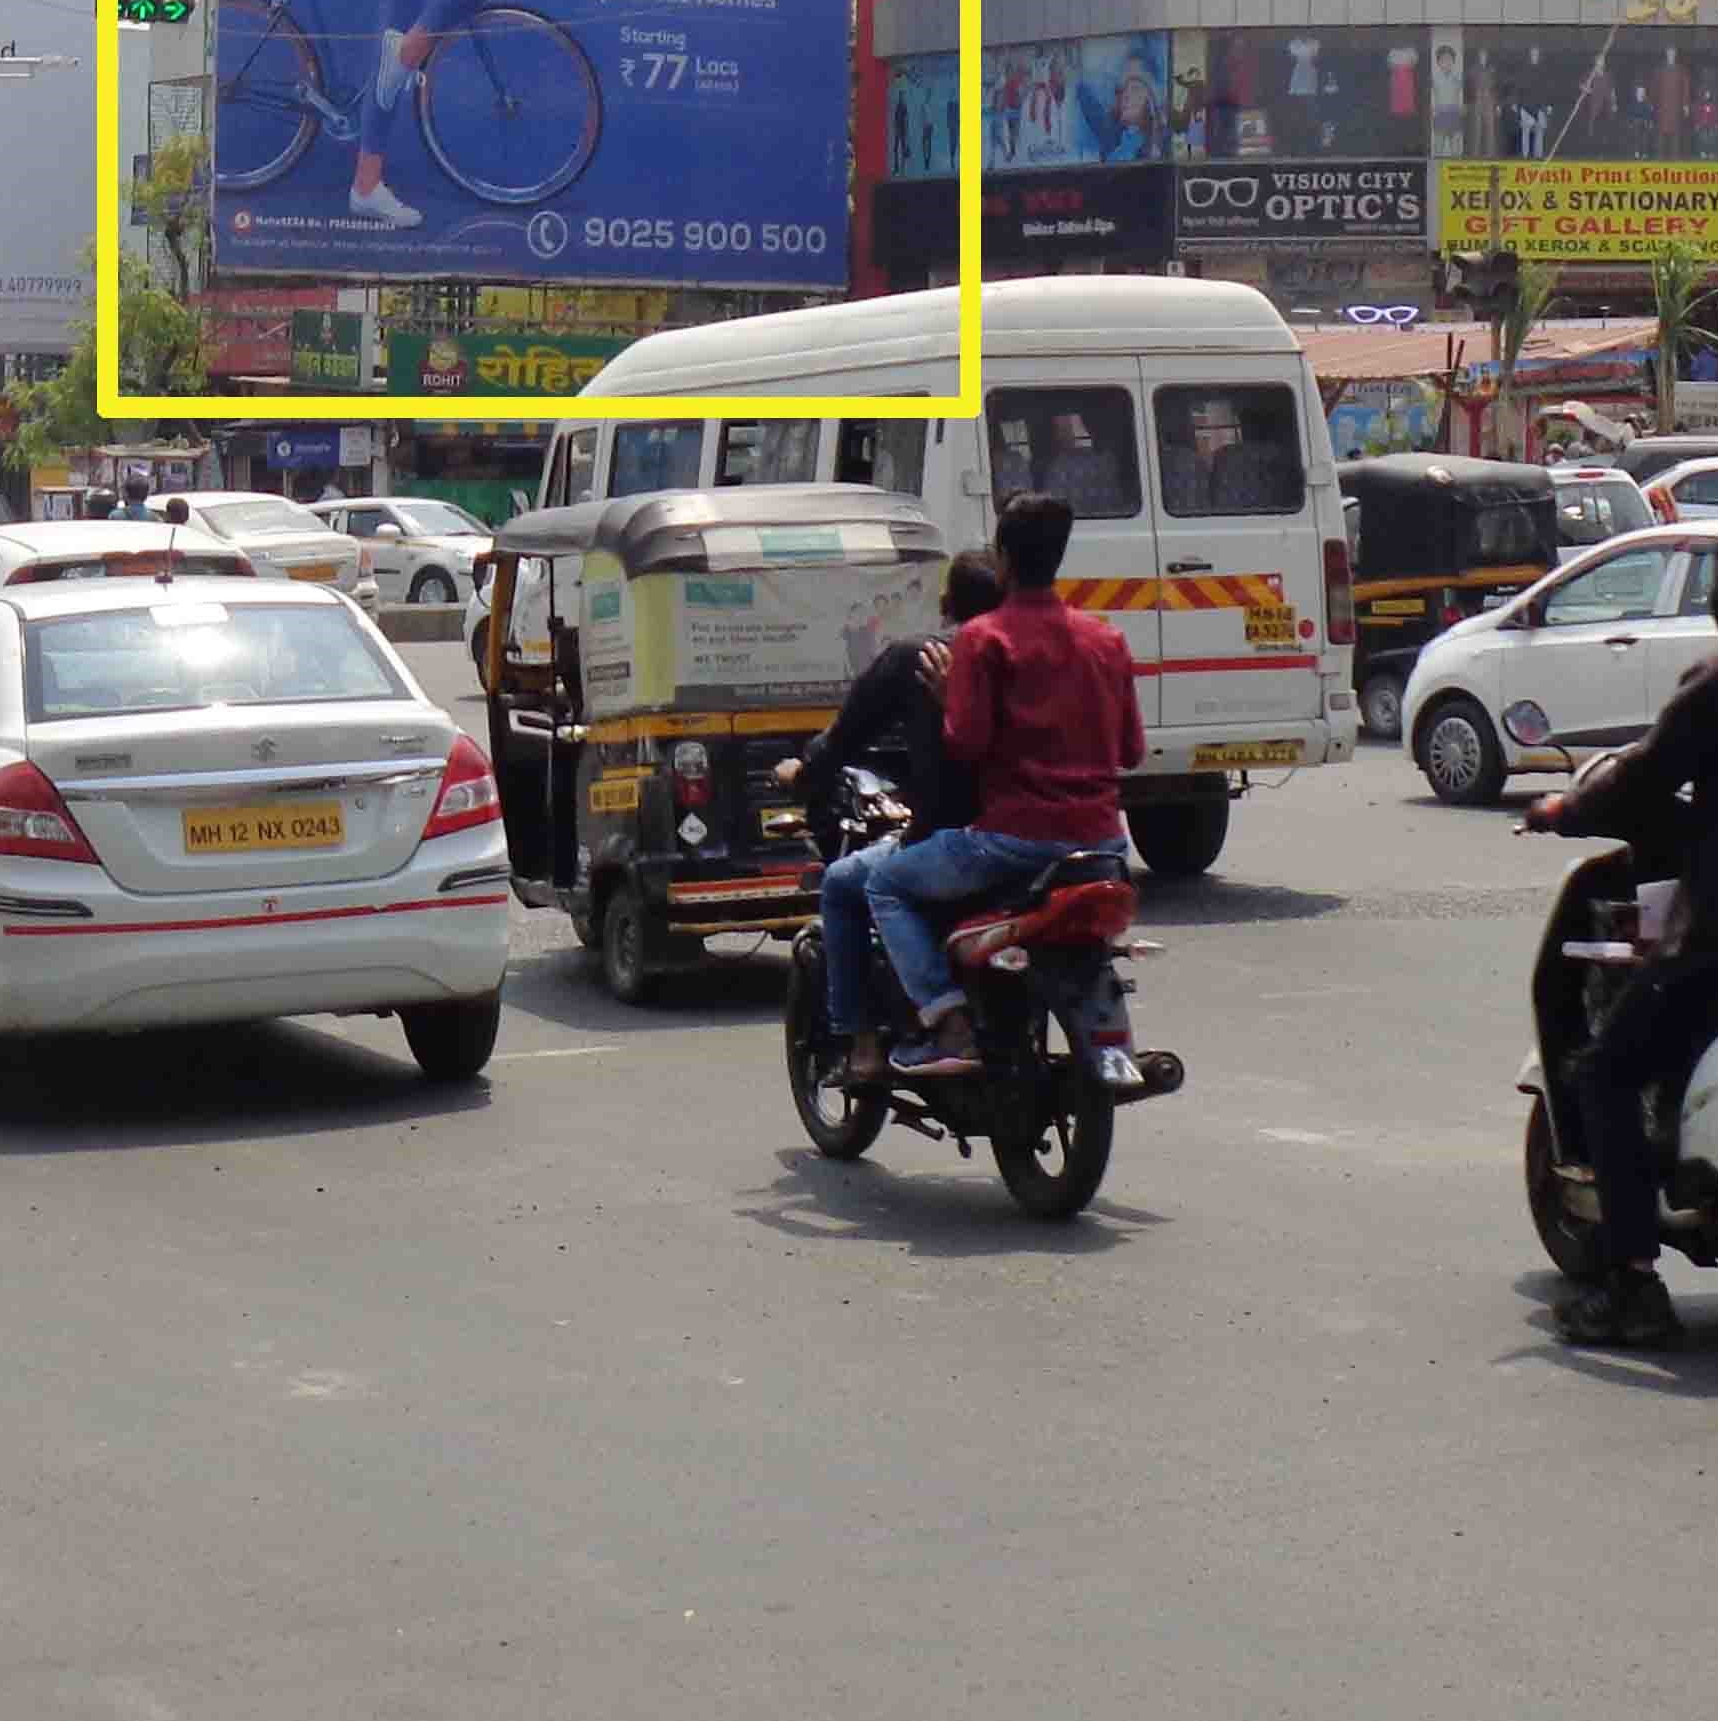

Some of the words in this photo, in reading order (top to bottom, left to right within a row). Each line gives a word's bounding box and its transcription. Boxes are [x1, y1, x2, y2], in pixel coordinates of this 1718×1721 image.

[620, 25, 687, 51] Starting
[642, 52, 689, 89] 77
[1271, 173, 1352, 191] VISION
[1359, 172, 1413, 190] CITY
[1582, 168, 1632, 185] Print
[1266, 195, 1421, 221] OPTIC'S
[1542, 191, 1558, 210] &
[584, 217, 674, 252] 9025
[683, 220, 753, 254] 900
[763, 224, 828, 256] 500
[1464, 217, 1542, 235] GFT
[1555, 217, 1710, 235] GALLERY
[1525, 239, 1589, 253] XEROX
[189, 823, 223, 846] MH
[228, 823, 250, 842] 12
[258, 820, 287, 841] NX
[292, 815, 341, 839] 0243
